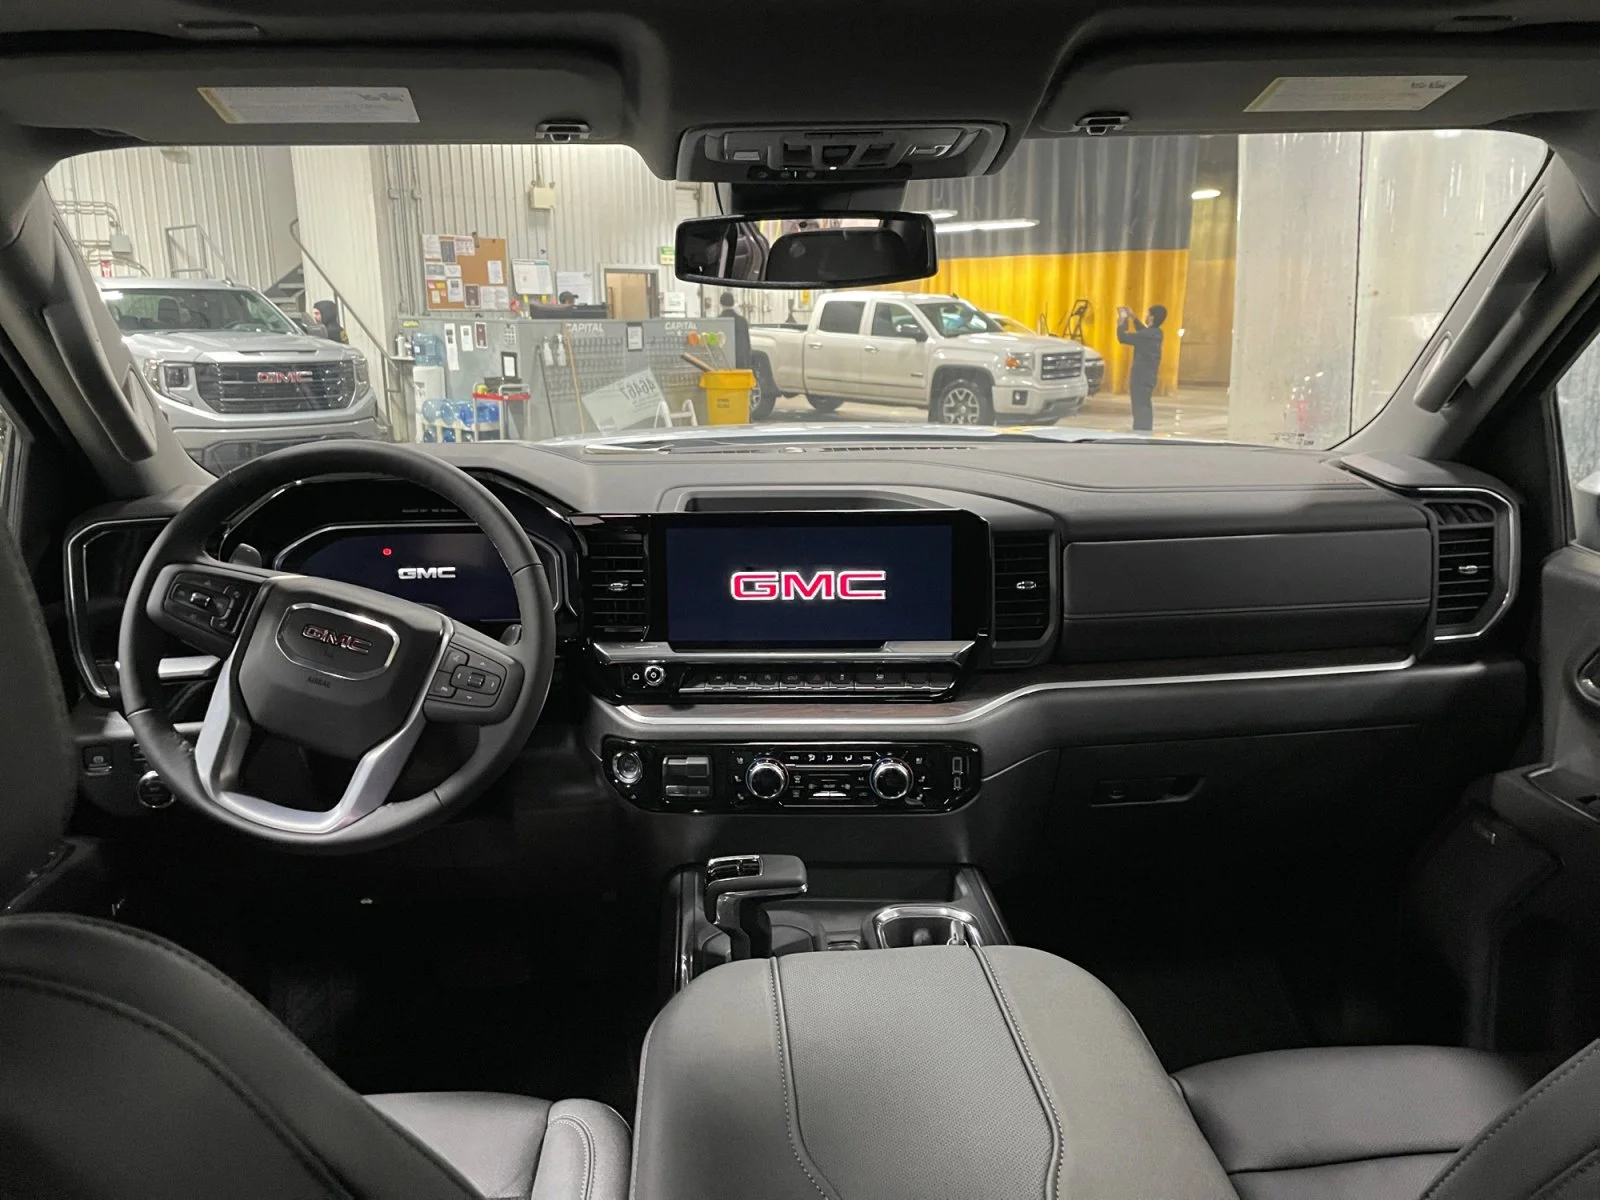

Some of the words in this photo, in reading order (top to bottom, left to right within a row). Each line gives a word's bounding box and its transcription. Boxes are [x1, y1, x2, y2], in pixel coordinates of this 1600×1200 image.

[664, 321, 698, 330] CAPITAL
[257, 370, 314, 384] GMC
[397, 566, 456, 580] GMC
[731, 571, 886, 601] GMC
[302, 624, 373, 655] GMC
